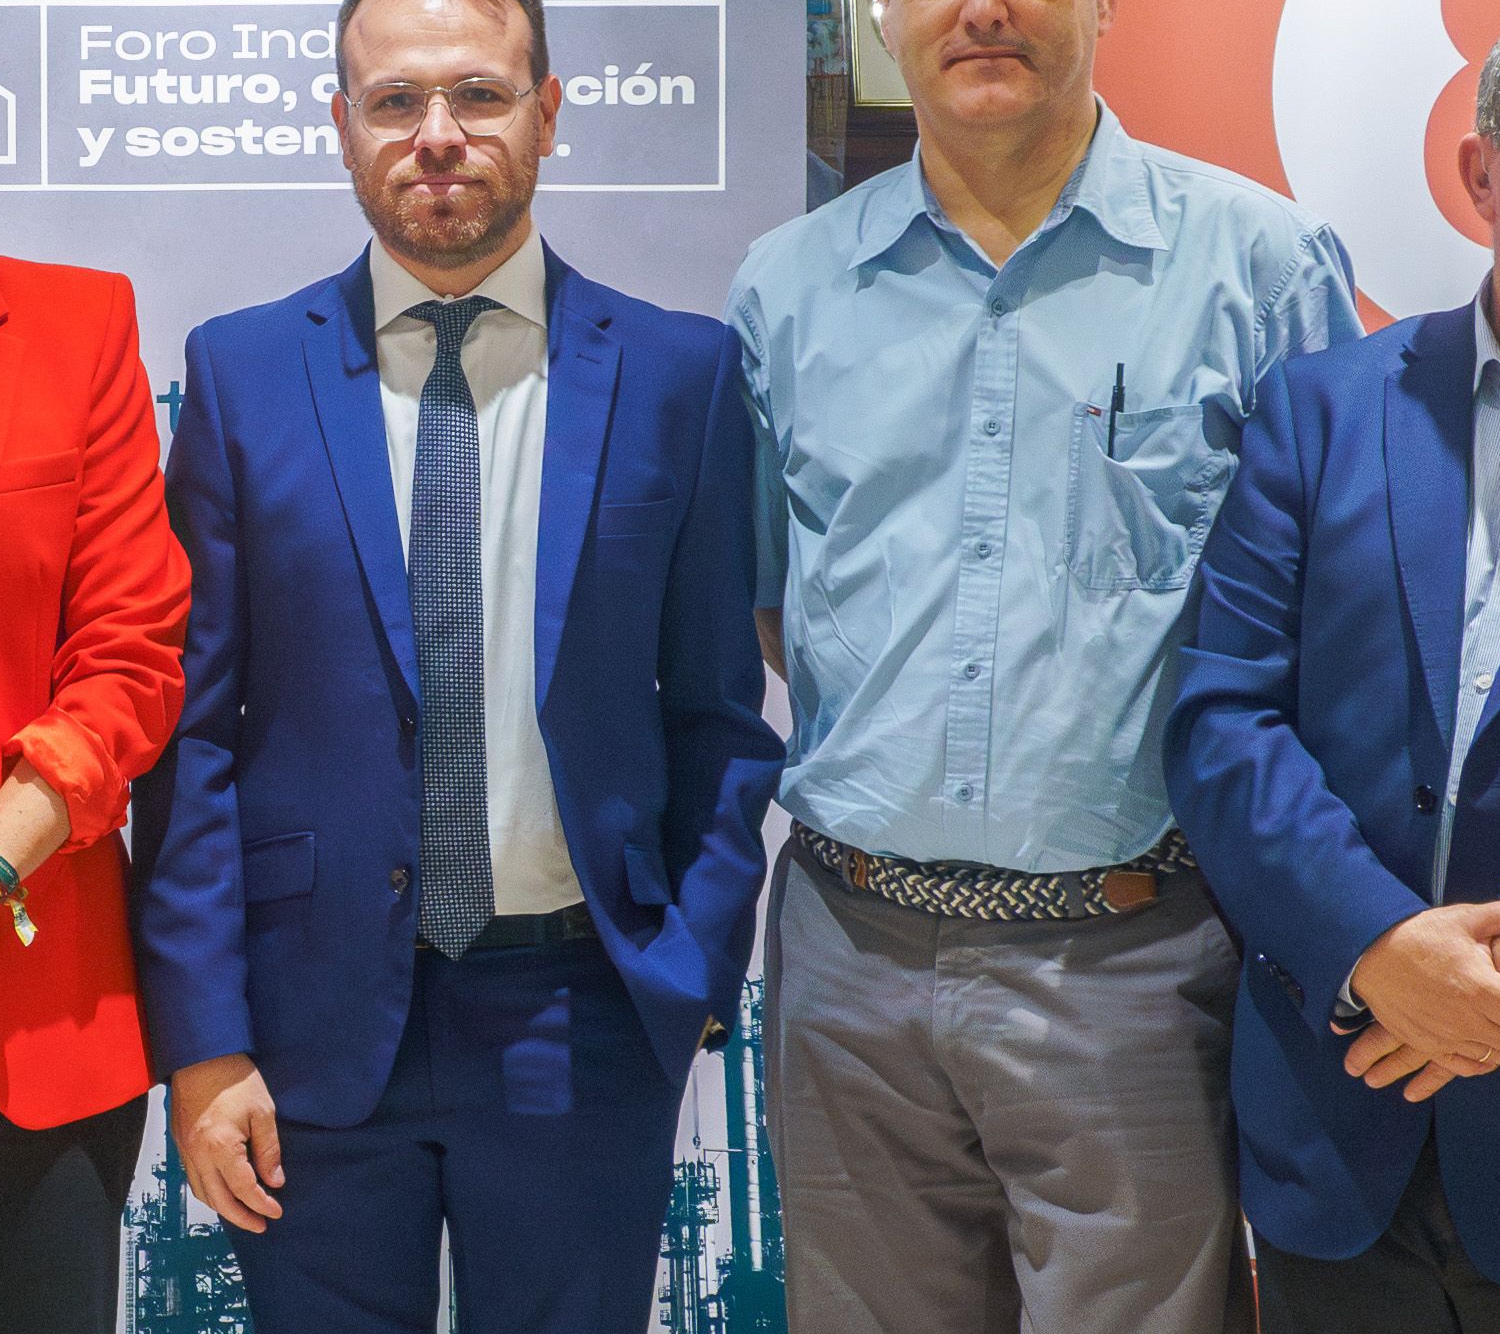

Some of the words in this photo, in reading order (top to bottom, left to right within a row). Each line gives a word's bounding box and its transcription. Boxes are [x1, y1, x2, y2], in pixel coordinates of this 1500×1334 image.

[79, 25, 217, 61] Foro
[231, 21, 337, 60] Ind
[78, 68, 298, 112] Futuro,
[565, 62, 696, 106] ción
[76, 126, 116, 167] y
[124, 118, 340, 157] sosten
